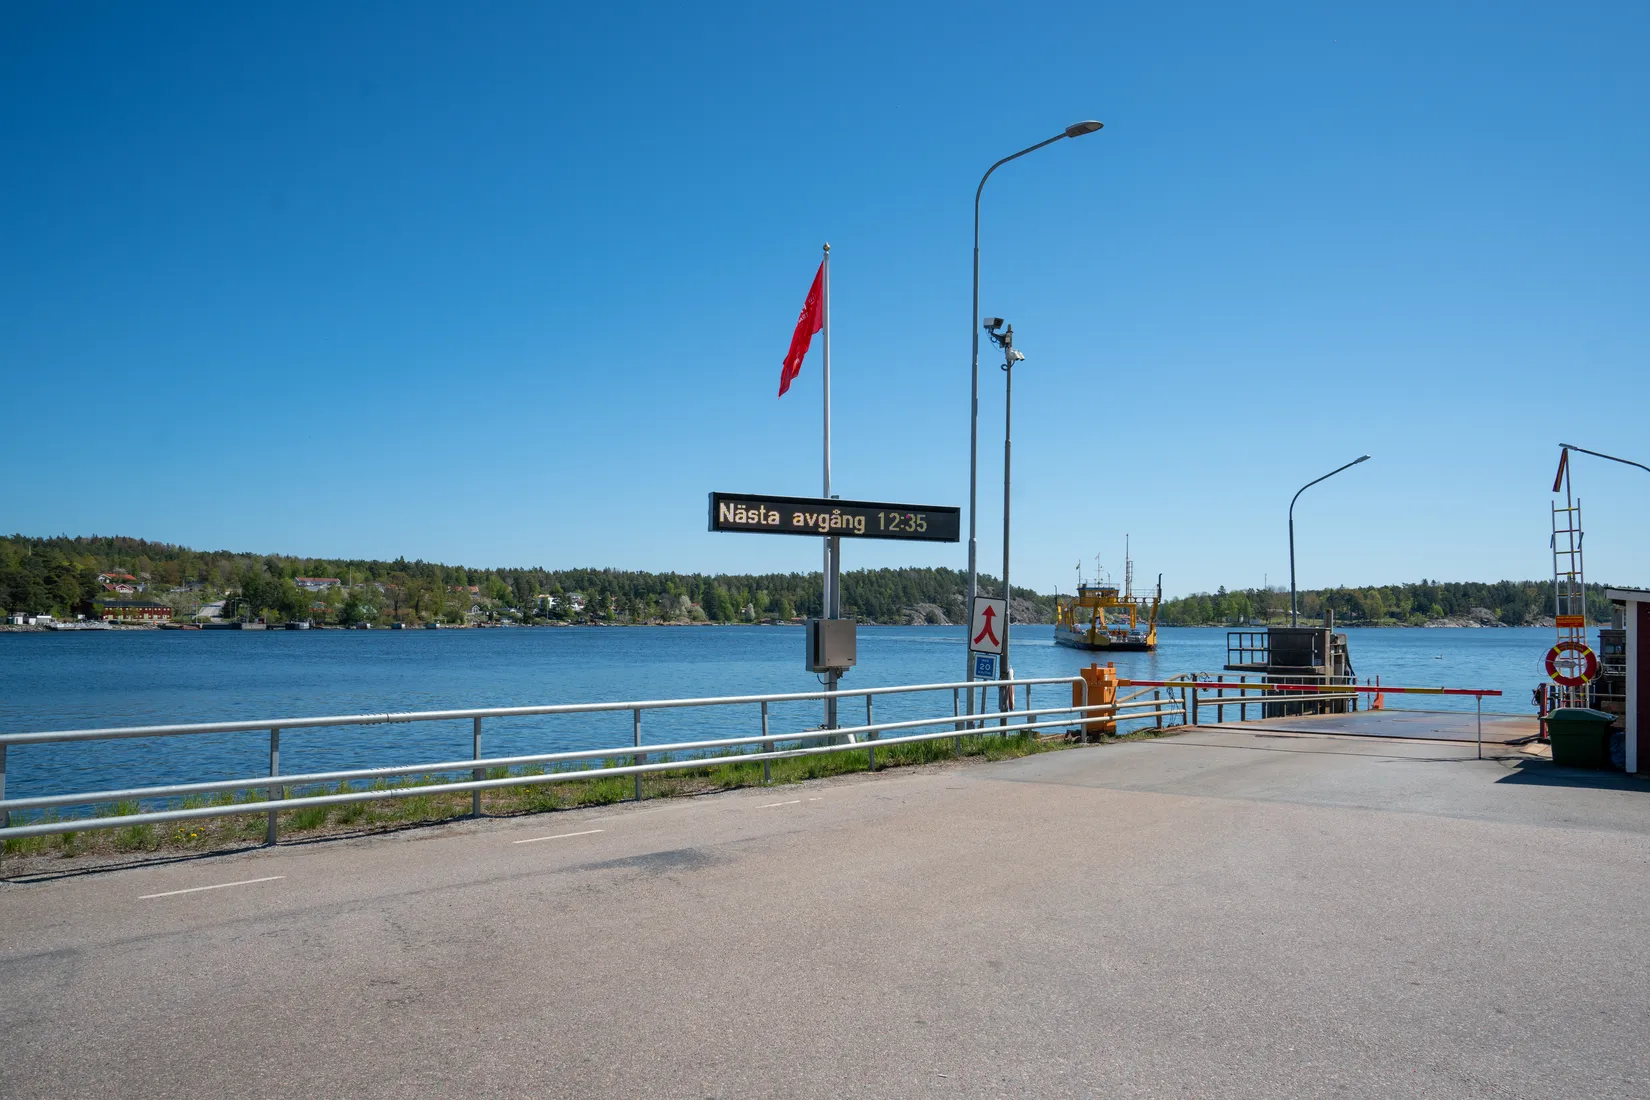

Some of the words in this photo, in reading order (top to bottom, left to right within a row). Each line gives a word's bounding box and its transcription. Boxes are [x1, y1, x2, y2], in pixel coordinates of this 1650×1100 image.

[719, 502, 780, 525] Nästa
[792, 509, 866, 534] avgång
[878, 511, 928, 532] 12:35
[979, 663, 991, 671] 20
